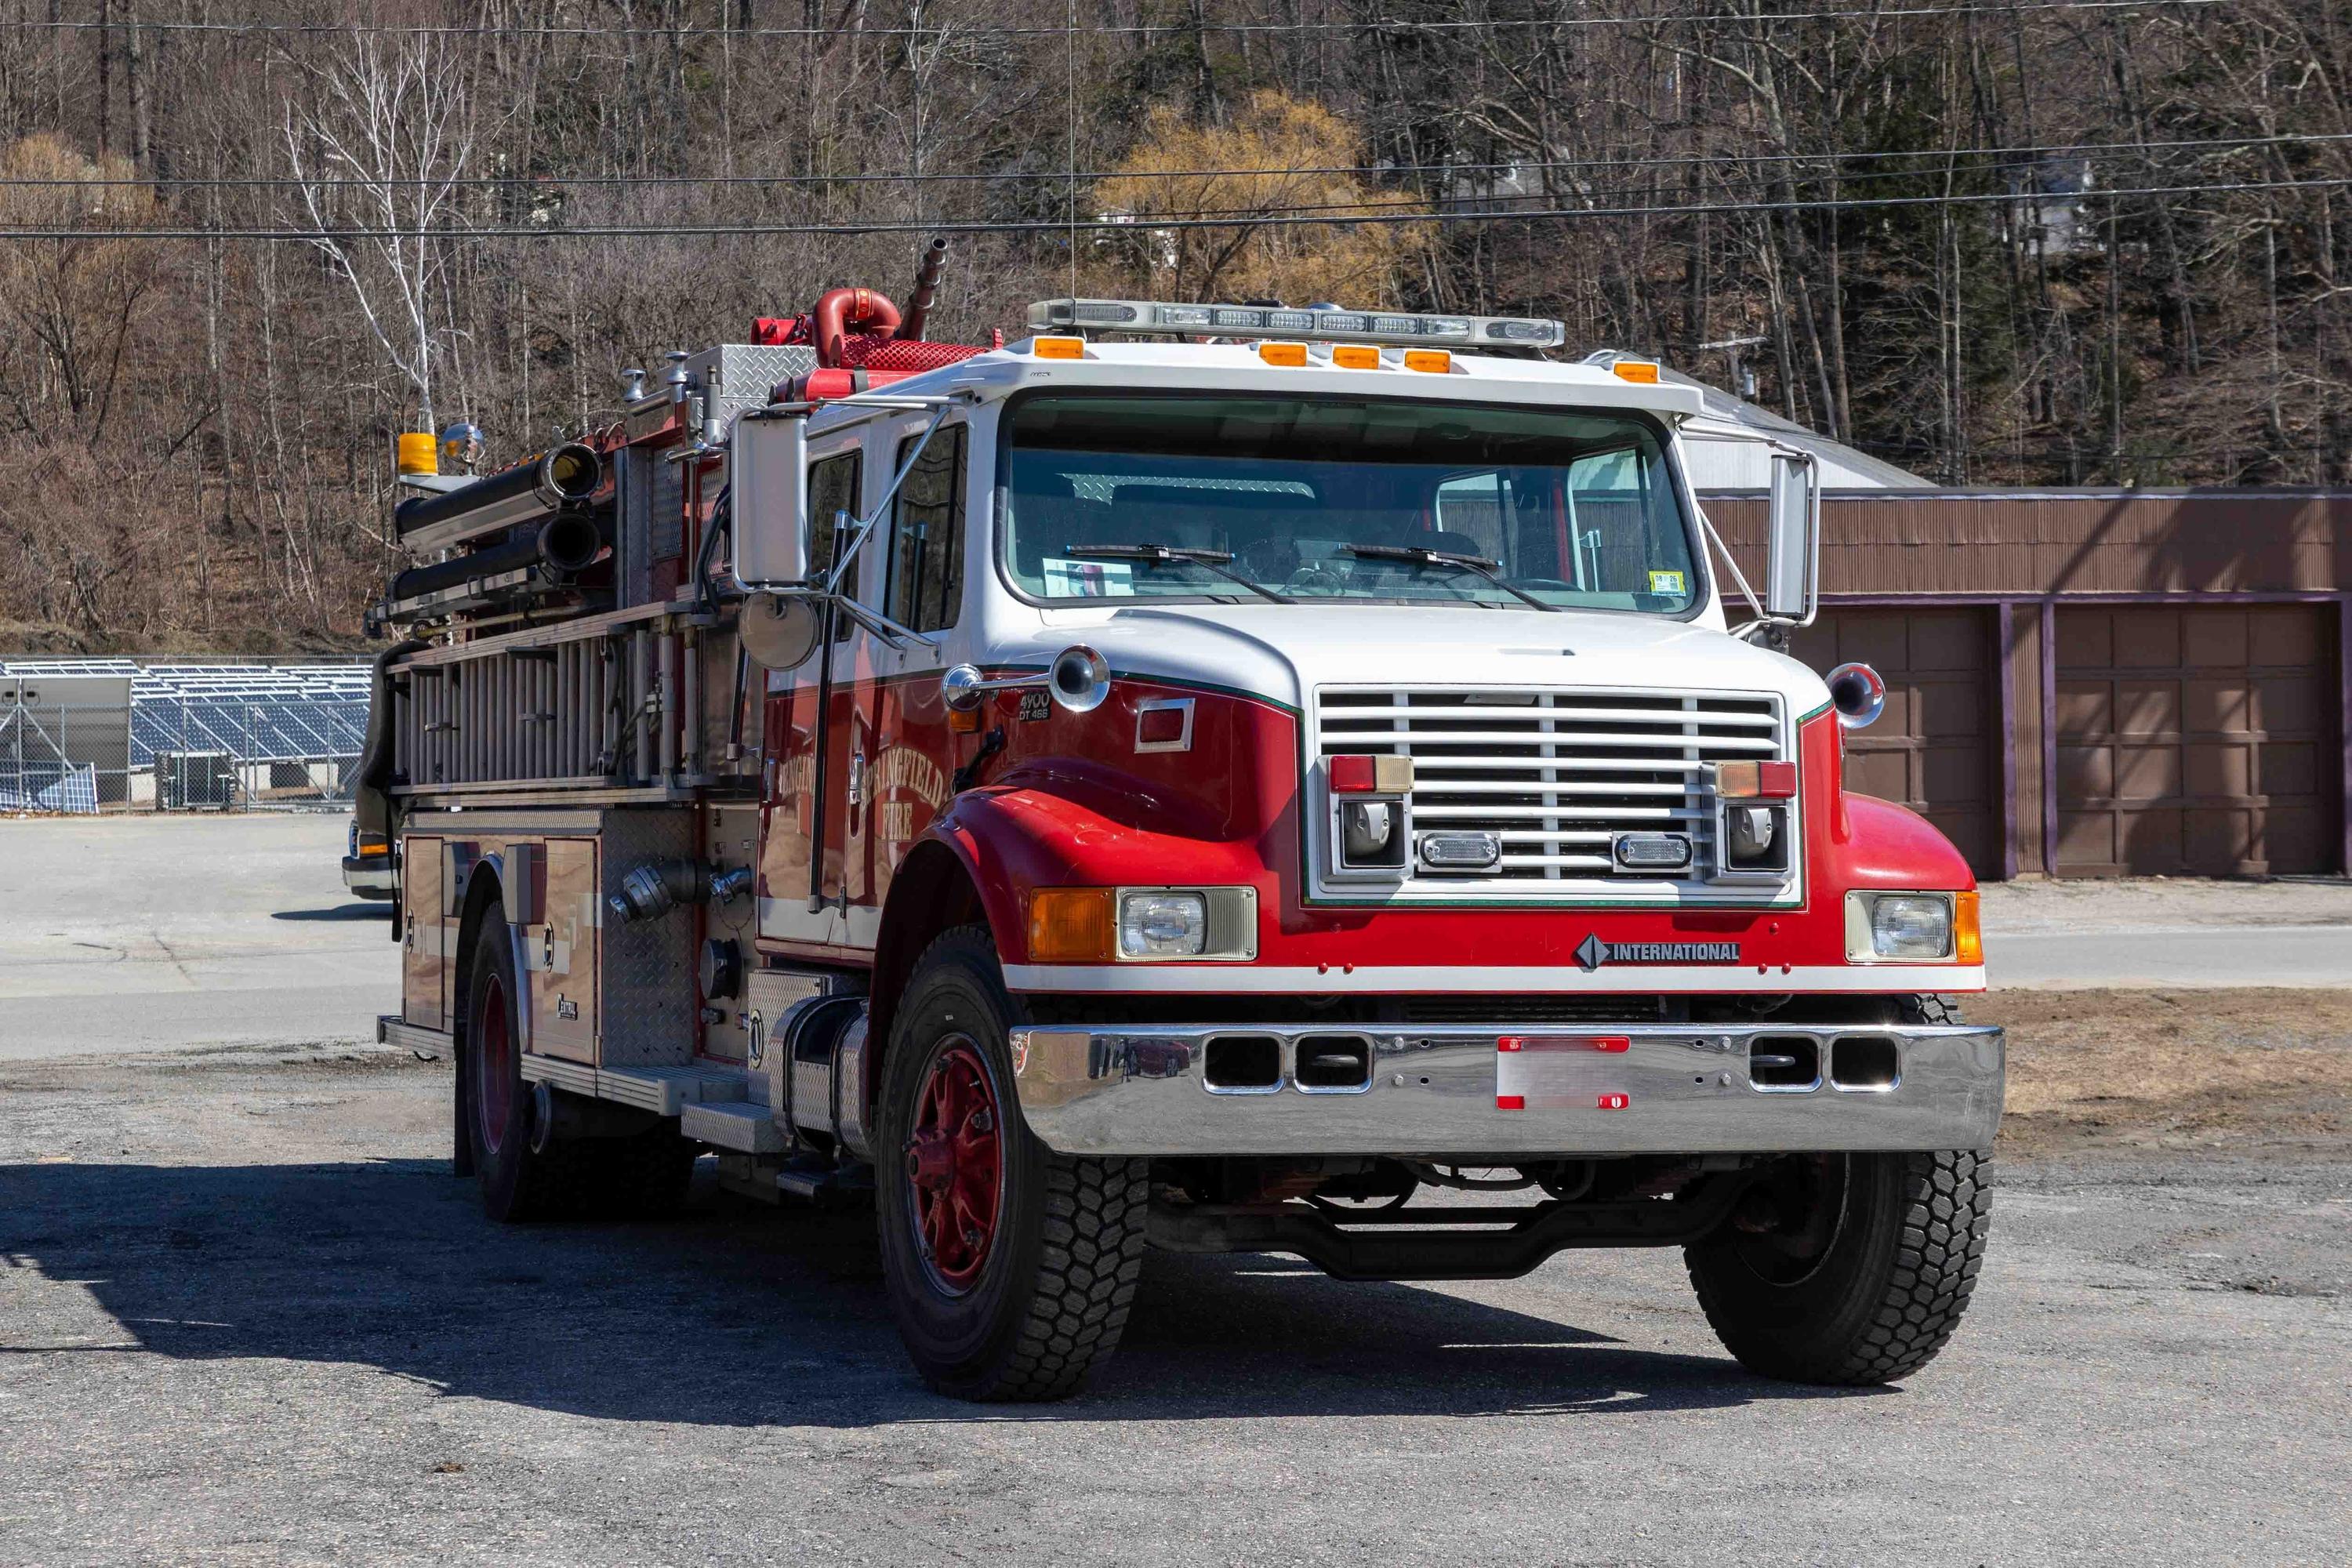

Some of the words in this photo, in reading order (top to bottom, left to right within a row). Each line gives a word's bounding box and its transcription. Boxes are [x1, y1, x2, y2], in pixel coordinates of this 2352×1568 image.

[1020, 710, 1030, 720] DT
[782, 755, 816, 798] ENGIN
[881, 802, 913, 840] FIRE
[1613, 944, 1740, 960] INTERNATIONAL
